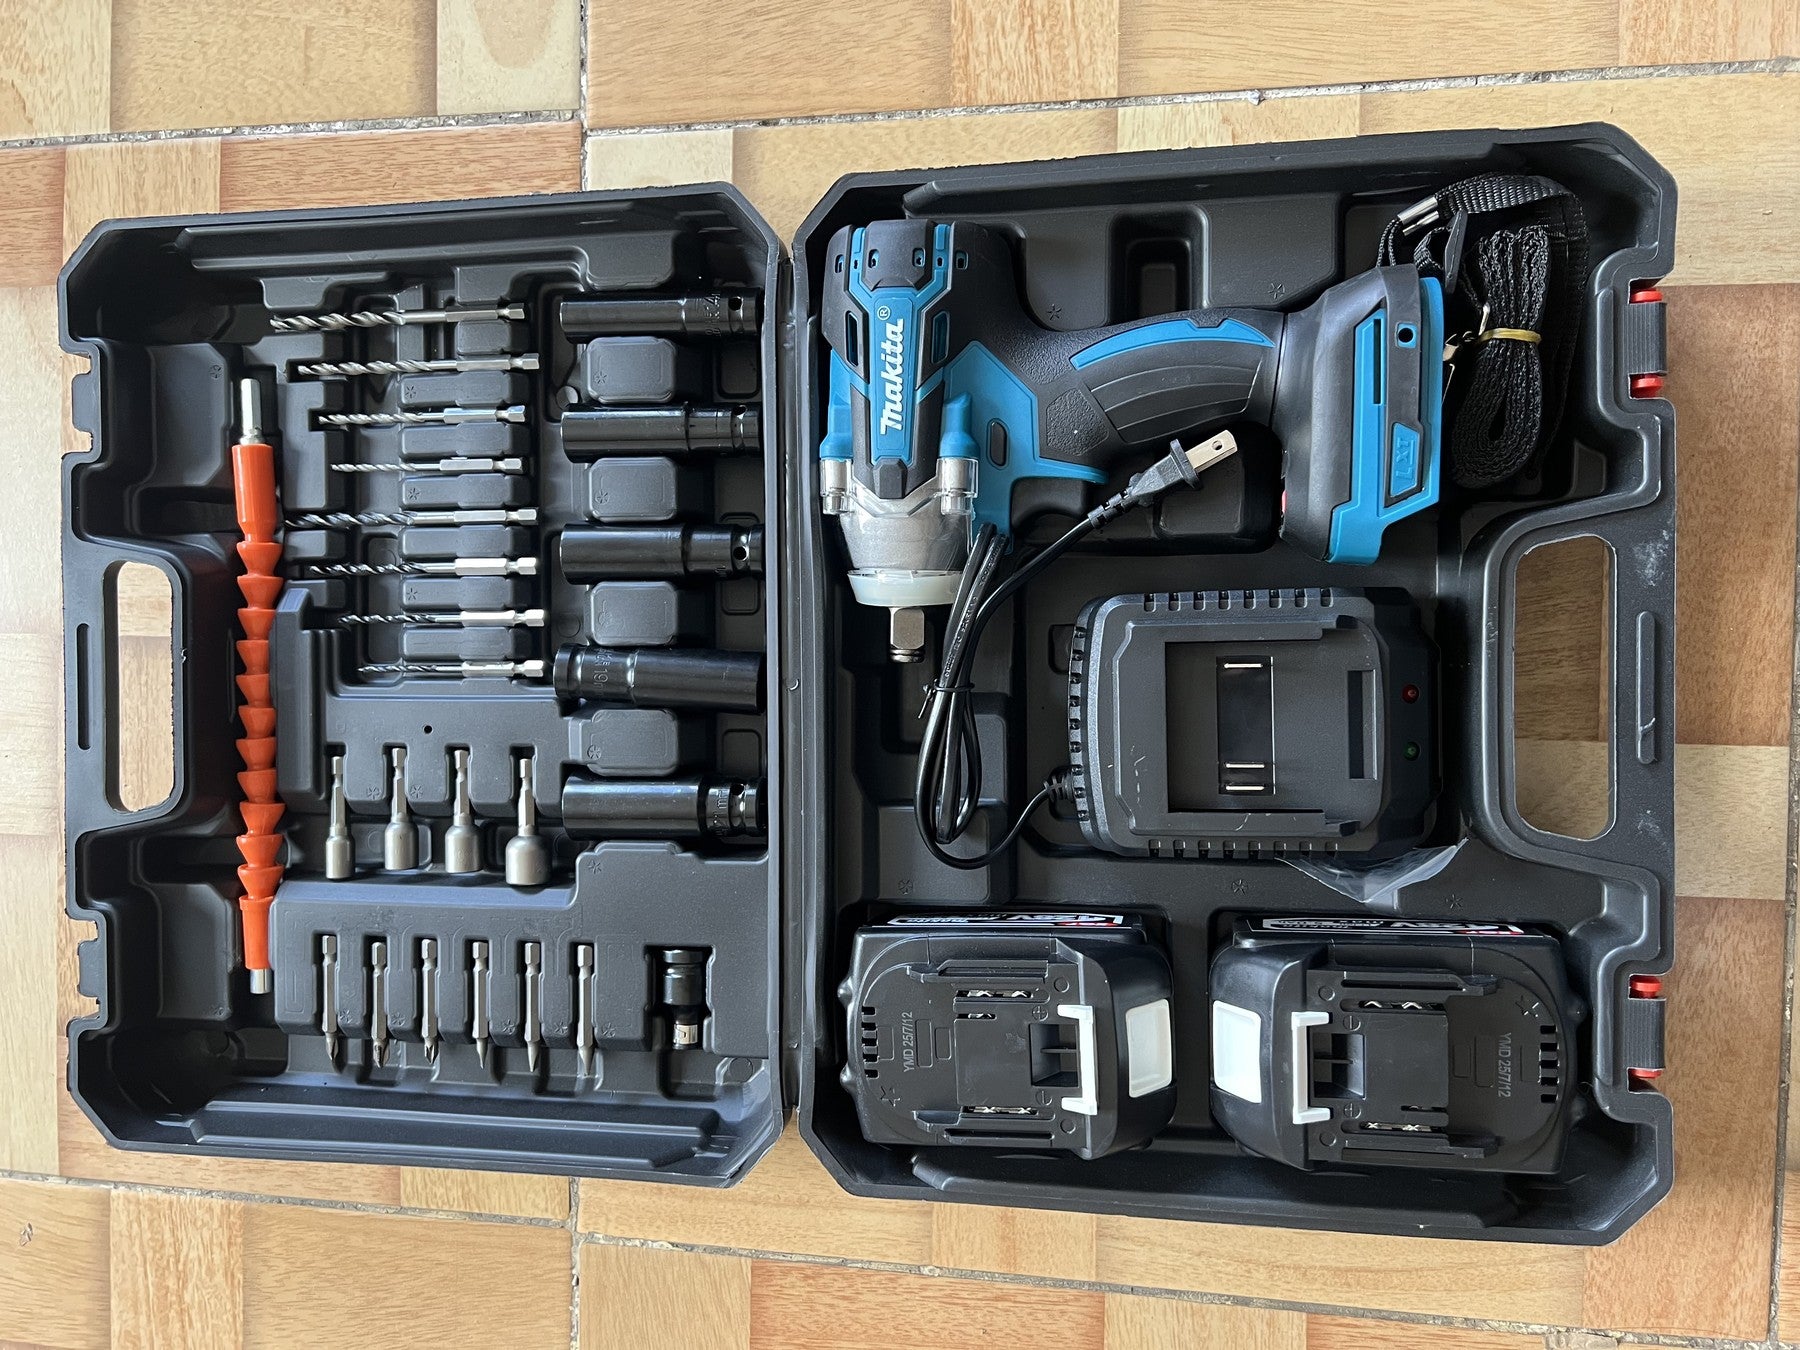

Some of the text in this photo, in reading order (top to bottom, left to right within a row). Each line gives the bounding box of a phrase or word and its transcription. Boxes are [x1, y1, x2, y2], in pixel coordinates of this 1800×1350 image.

[1395, 436, 1413, 479] LXT
[901, 1011, 915, 1073] YMD 25/7/12
[1498, 1032, 1512, 1098] YMD 25/7/12
